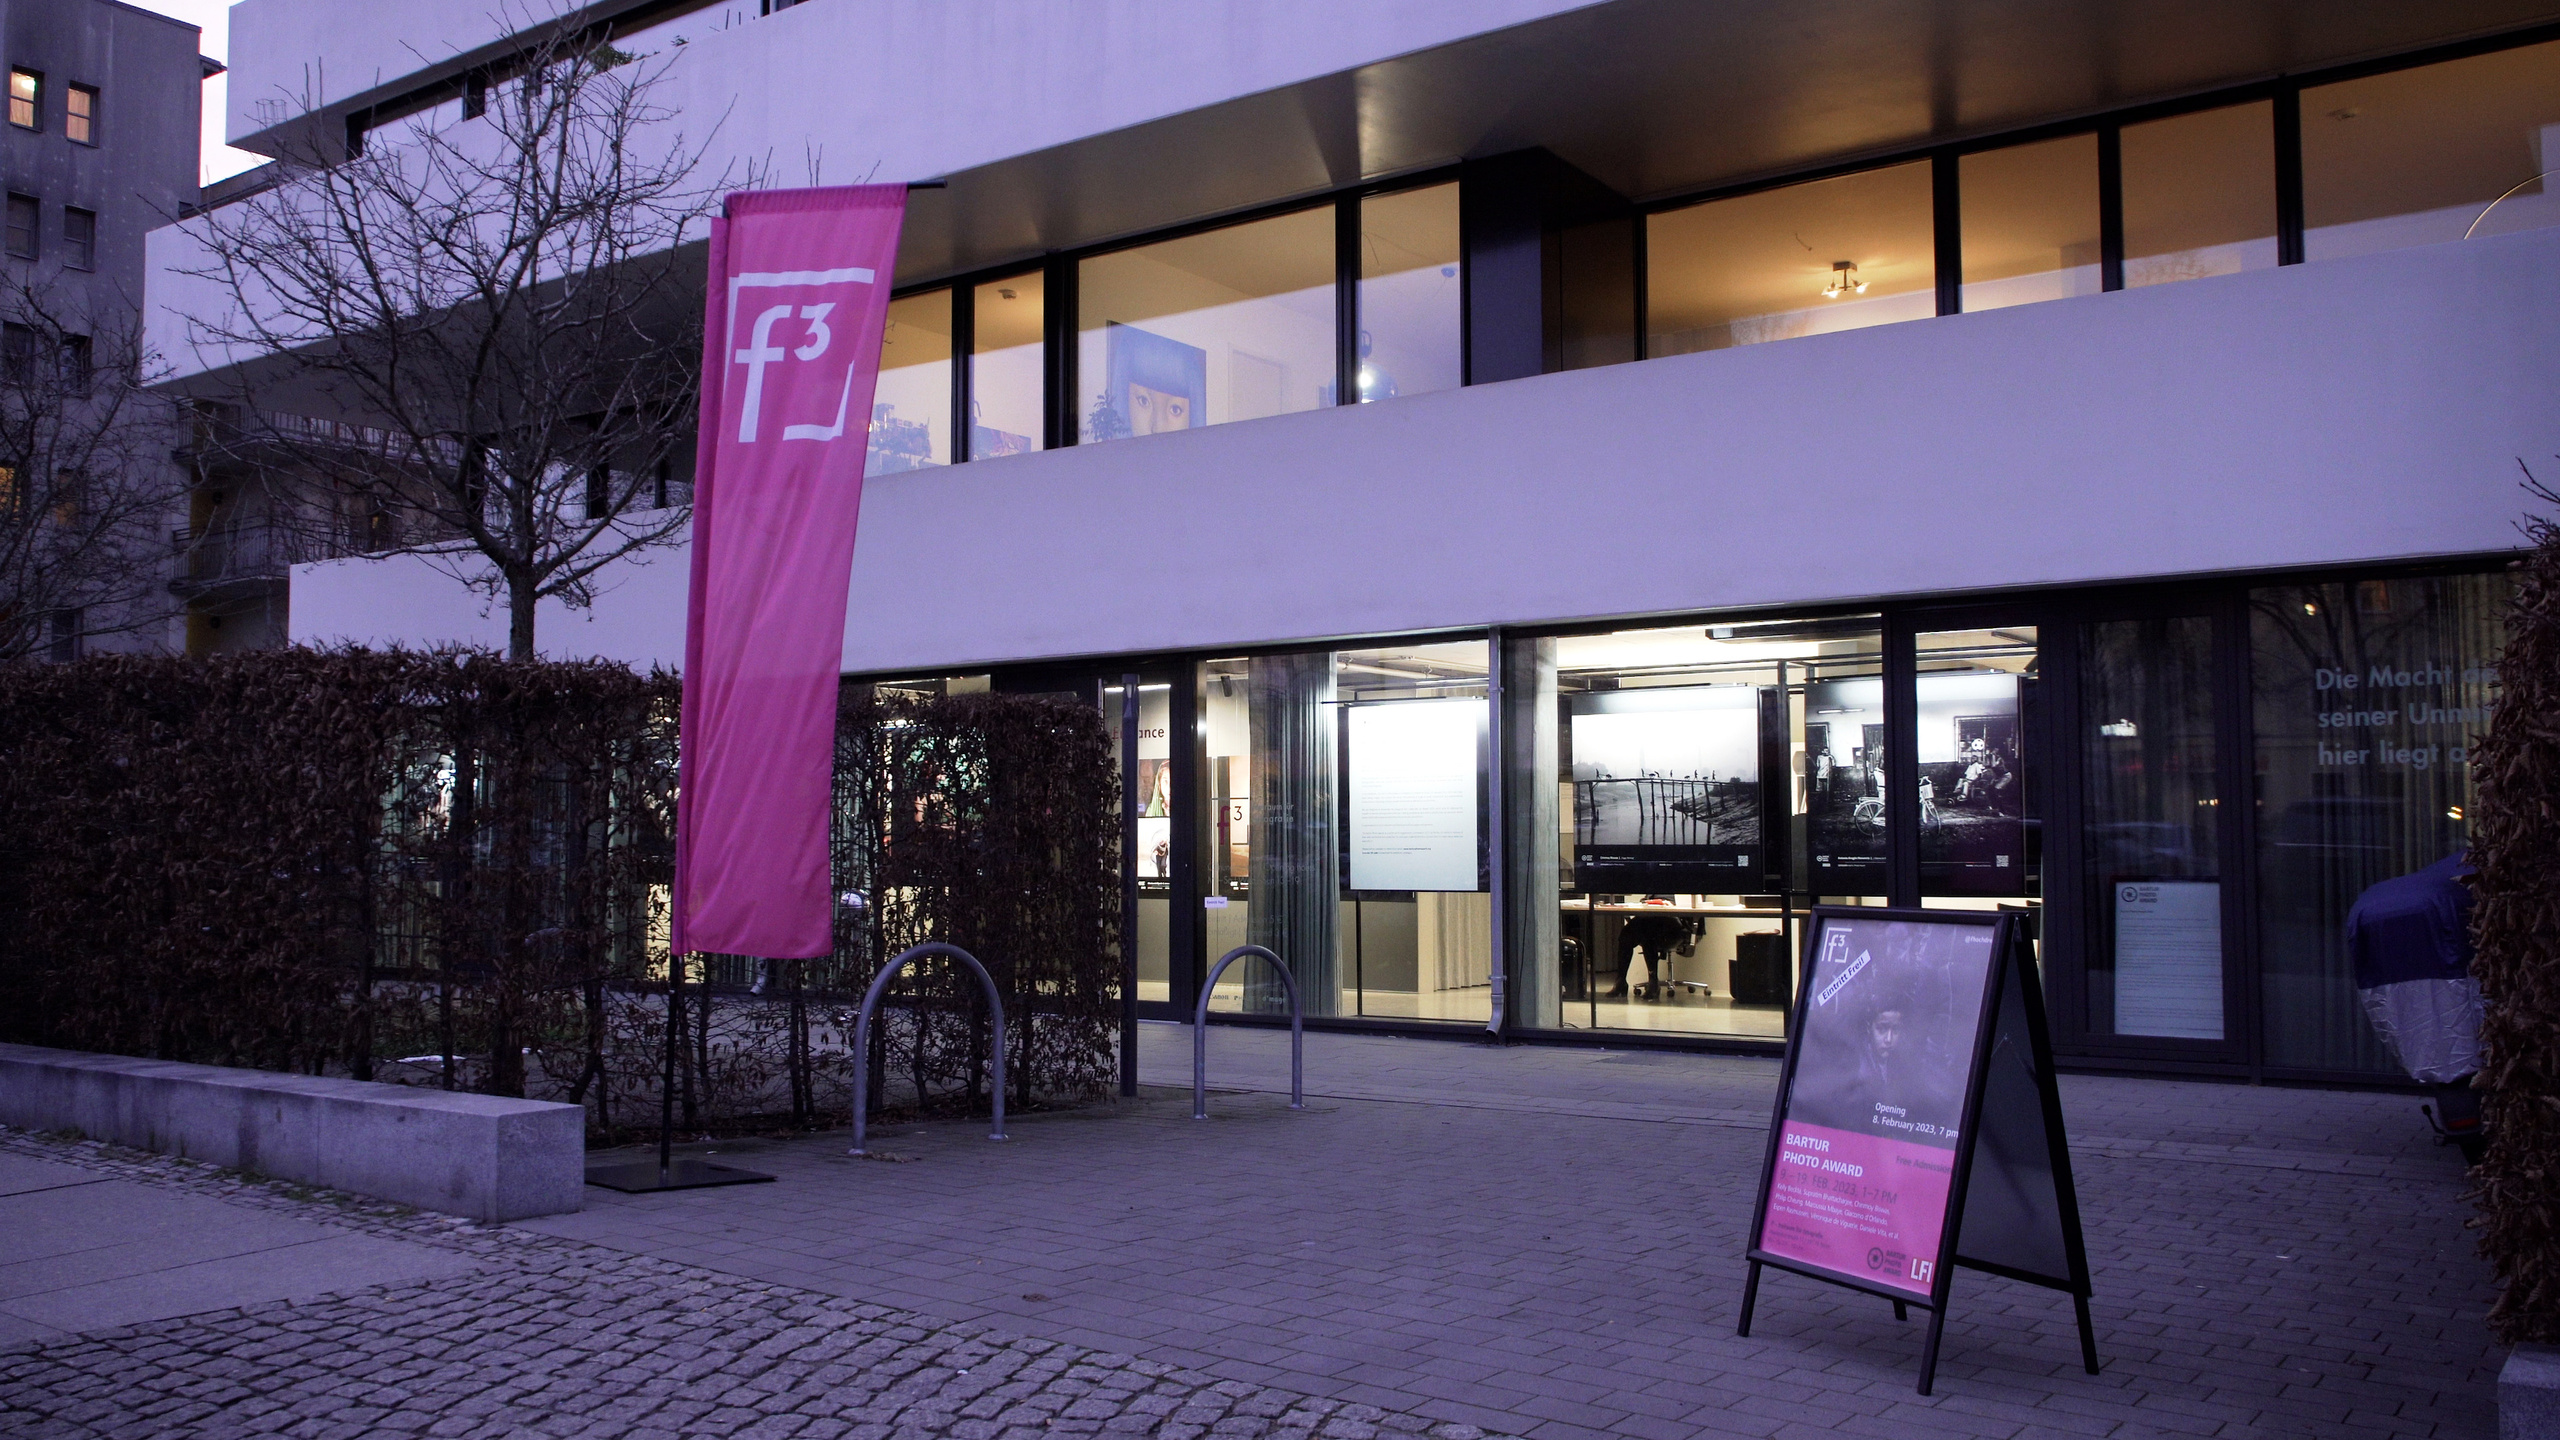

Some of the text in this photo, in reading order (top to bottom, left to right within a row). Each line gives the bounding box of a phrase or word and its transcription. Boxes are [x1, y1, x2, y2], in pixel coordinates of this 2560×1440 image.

[2315, 667, 2359, 690] Die
[2368, 661, 2452, 688] Macht
[2318, 705, 2398, 728] seiner
[2318, 741, 2370, 765] hier
[2379, 739, 2439, 770] liegt
[1822, 957, 1866, 1000] Eintritt Frei!
[1875, 1102, 1906, 1117] Opening
[1872, 1115, 1958, 1138] 8. February 2023, 7 pm
[1786, 1133, 1830, 1152] BARTUR
[1783, 1150, 1864, 1178] PHOTO AWARD
[1896, 1155, 1952, 1175] Free Admission
[1832, 1180, 1858, 1196] 2023,
[1881, 1190, 1898, 1204] PM
[1911, 1258, 1934, 1283] LFI
